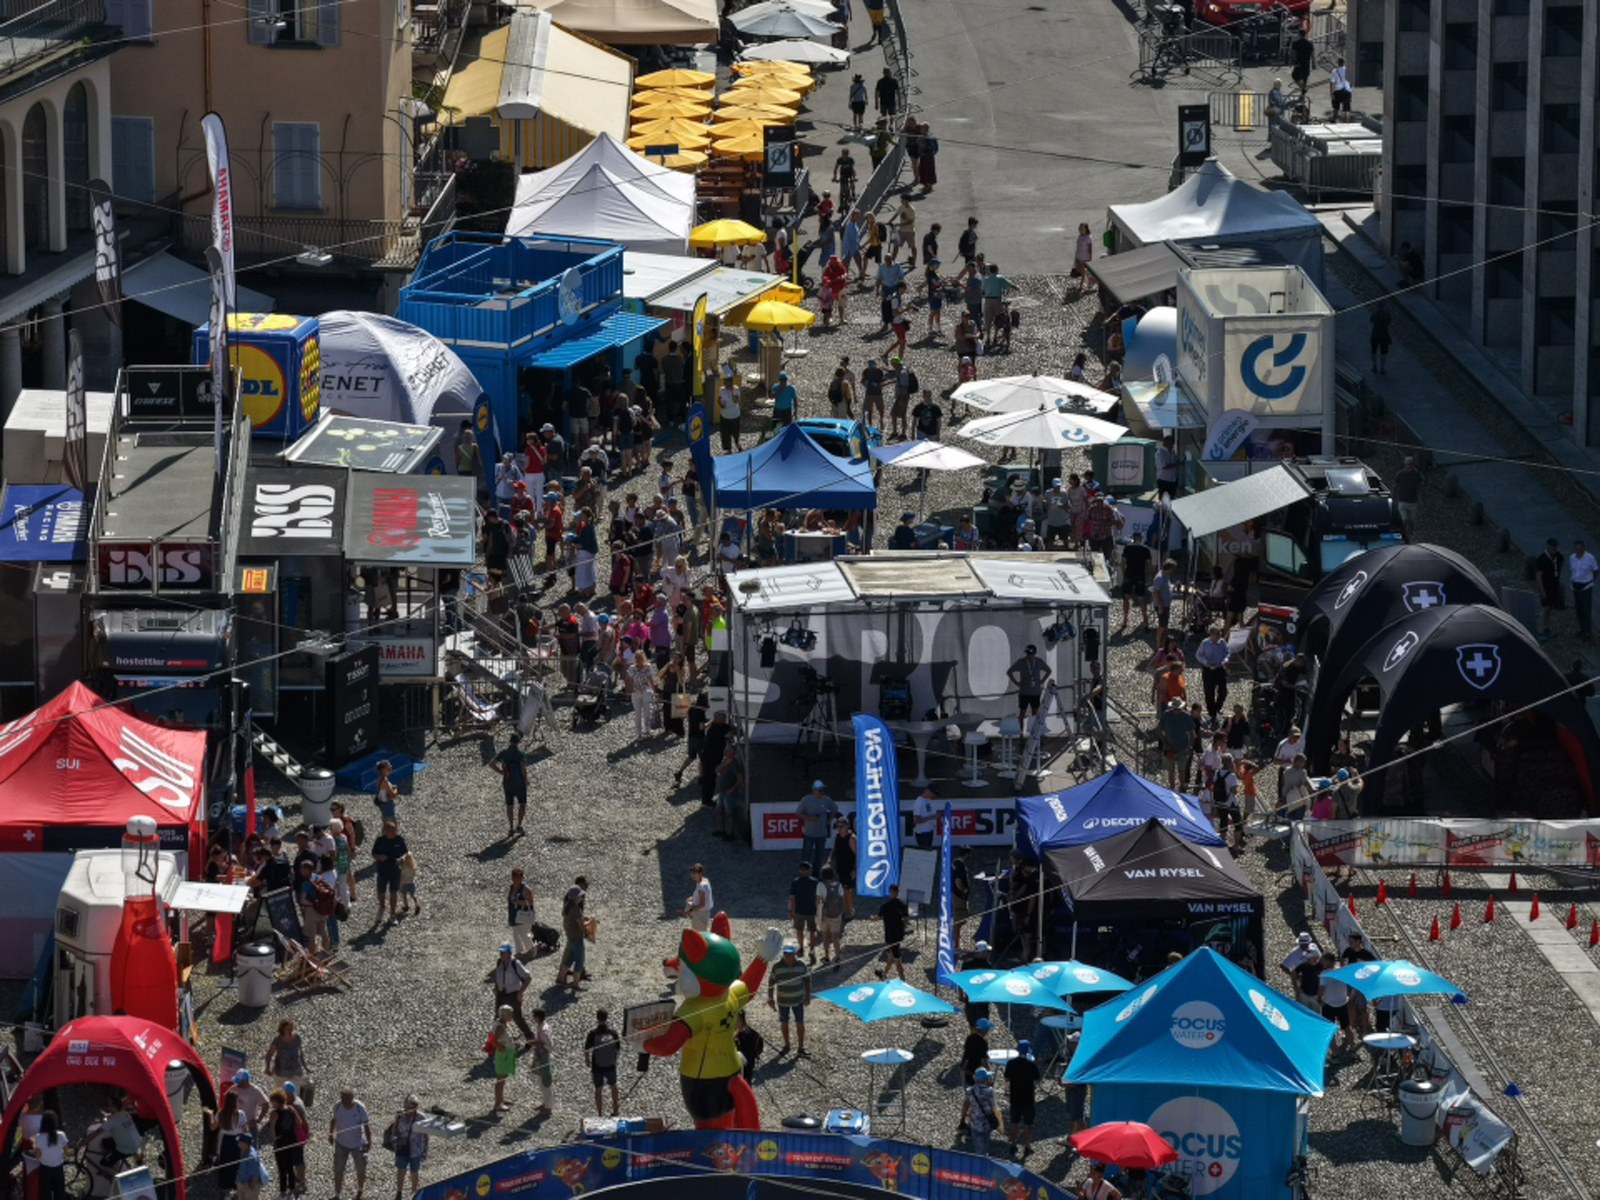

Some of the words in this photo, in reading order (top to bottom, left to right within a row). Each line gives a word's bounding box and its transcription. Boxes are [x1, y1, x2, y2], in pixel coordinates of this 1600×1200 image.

[242, 380, 279, 396] DL
[321, 375, 385, 392] ENET
[1221, 419, 1250, 449] energie
[380, 645, 426, 659] AMAHA
[115, 656, 166, 667] hostettler
[56, 758, 81, 770] SUI
[864, 727, 887, 858] DECATHLON
[767, 819, 800, 833] SRF
[1101, 816, 1177, 827] DECATHON
[1124, 869, 1156, 879] VAN
[1160, 868, 1205, 878] RYSEL
[1187, 902, 1213, 913] VAN
[1216, 903, 1255, 913] RYSEL
[1172, 1017, 1226, 1032] FOCUS
[1160, 1131, 1242, 1159] OCUS
[1161, 1160, 1206, 1177] ATER
